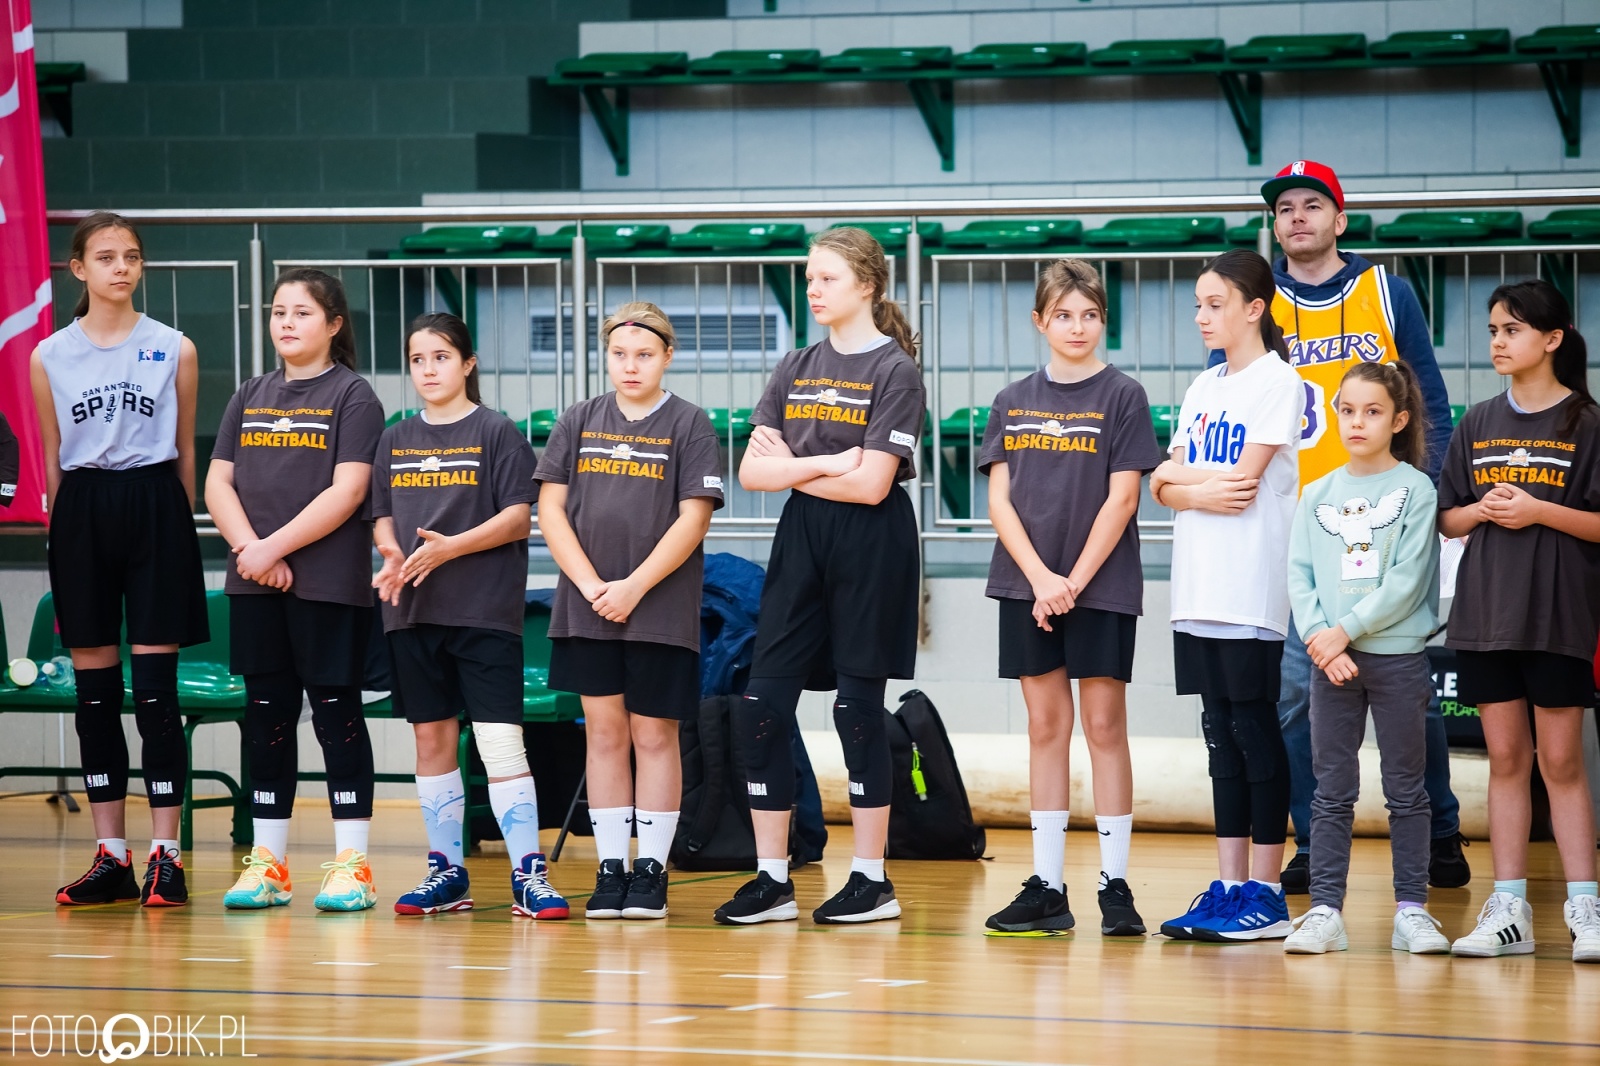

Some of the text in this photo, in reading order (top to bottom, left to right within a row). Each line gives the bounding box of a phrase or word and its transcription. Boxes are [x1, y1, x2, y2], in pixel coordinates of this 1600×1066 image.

[82, 381, 142, 398] SAN ANTONIO
[1024, 409, 1065, 420] STRZELCE
[1065, 411, 1105, 420] OPOLSKIE
[1004, 433, 1098, 454] BASKETBALL
[1490, 438, 1532, 447] STRZELCE
[1533, 439, 1576, 452] OPOLSKIE
[390, 470, 479, 488] ASKETBALL
[92, 773, 110, 787] NBA
[157, 781, 174, 794] NBA
[751, 782, 768, 796] NBA
[259, 791, 276, 804] NBA
[340, 791, 357, 804] NBA
